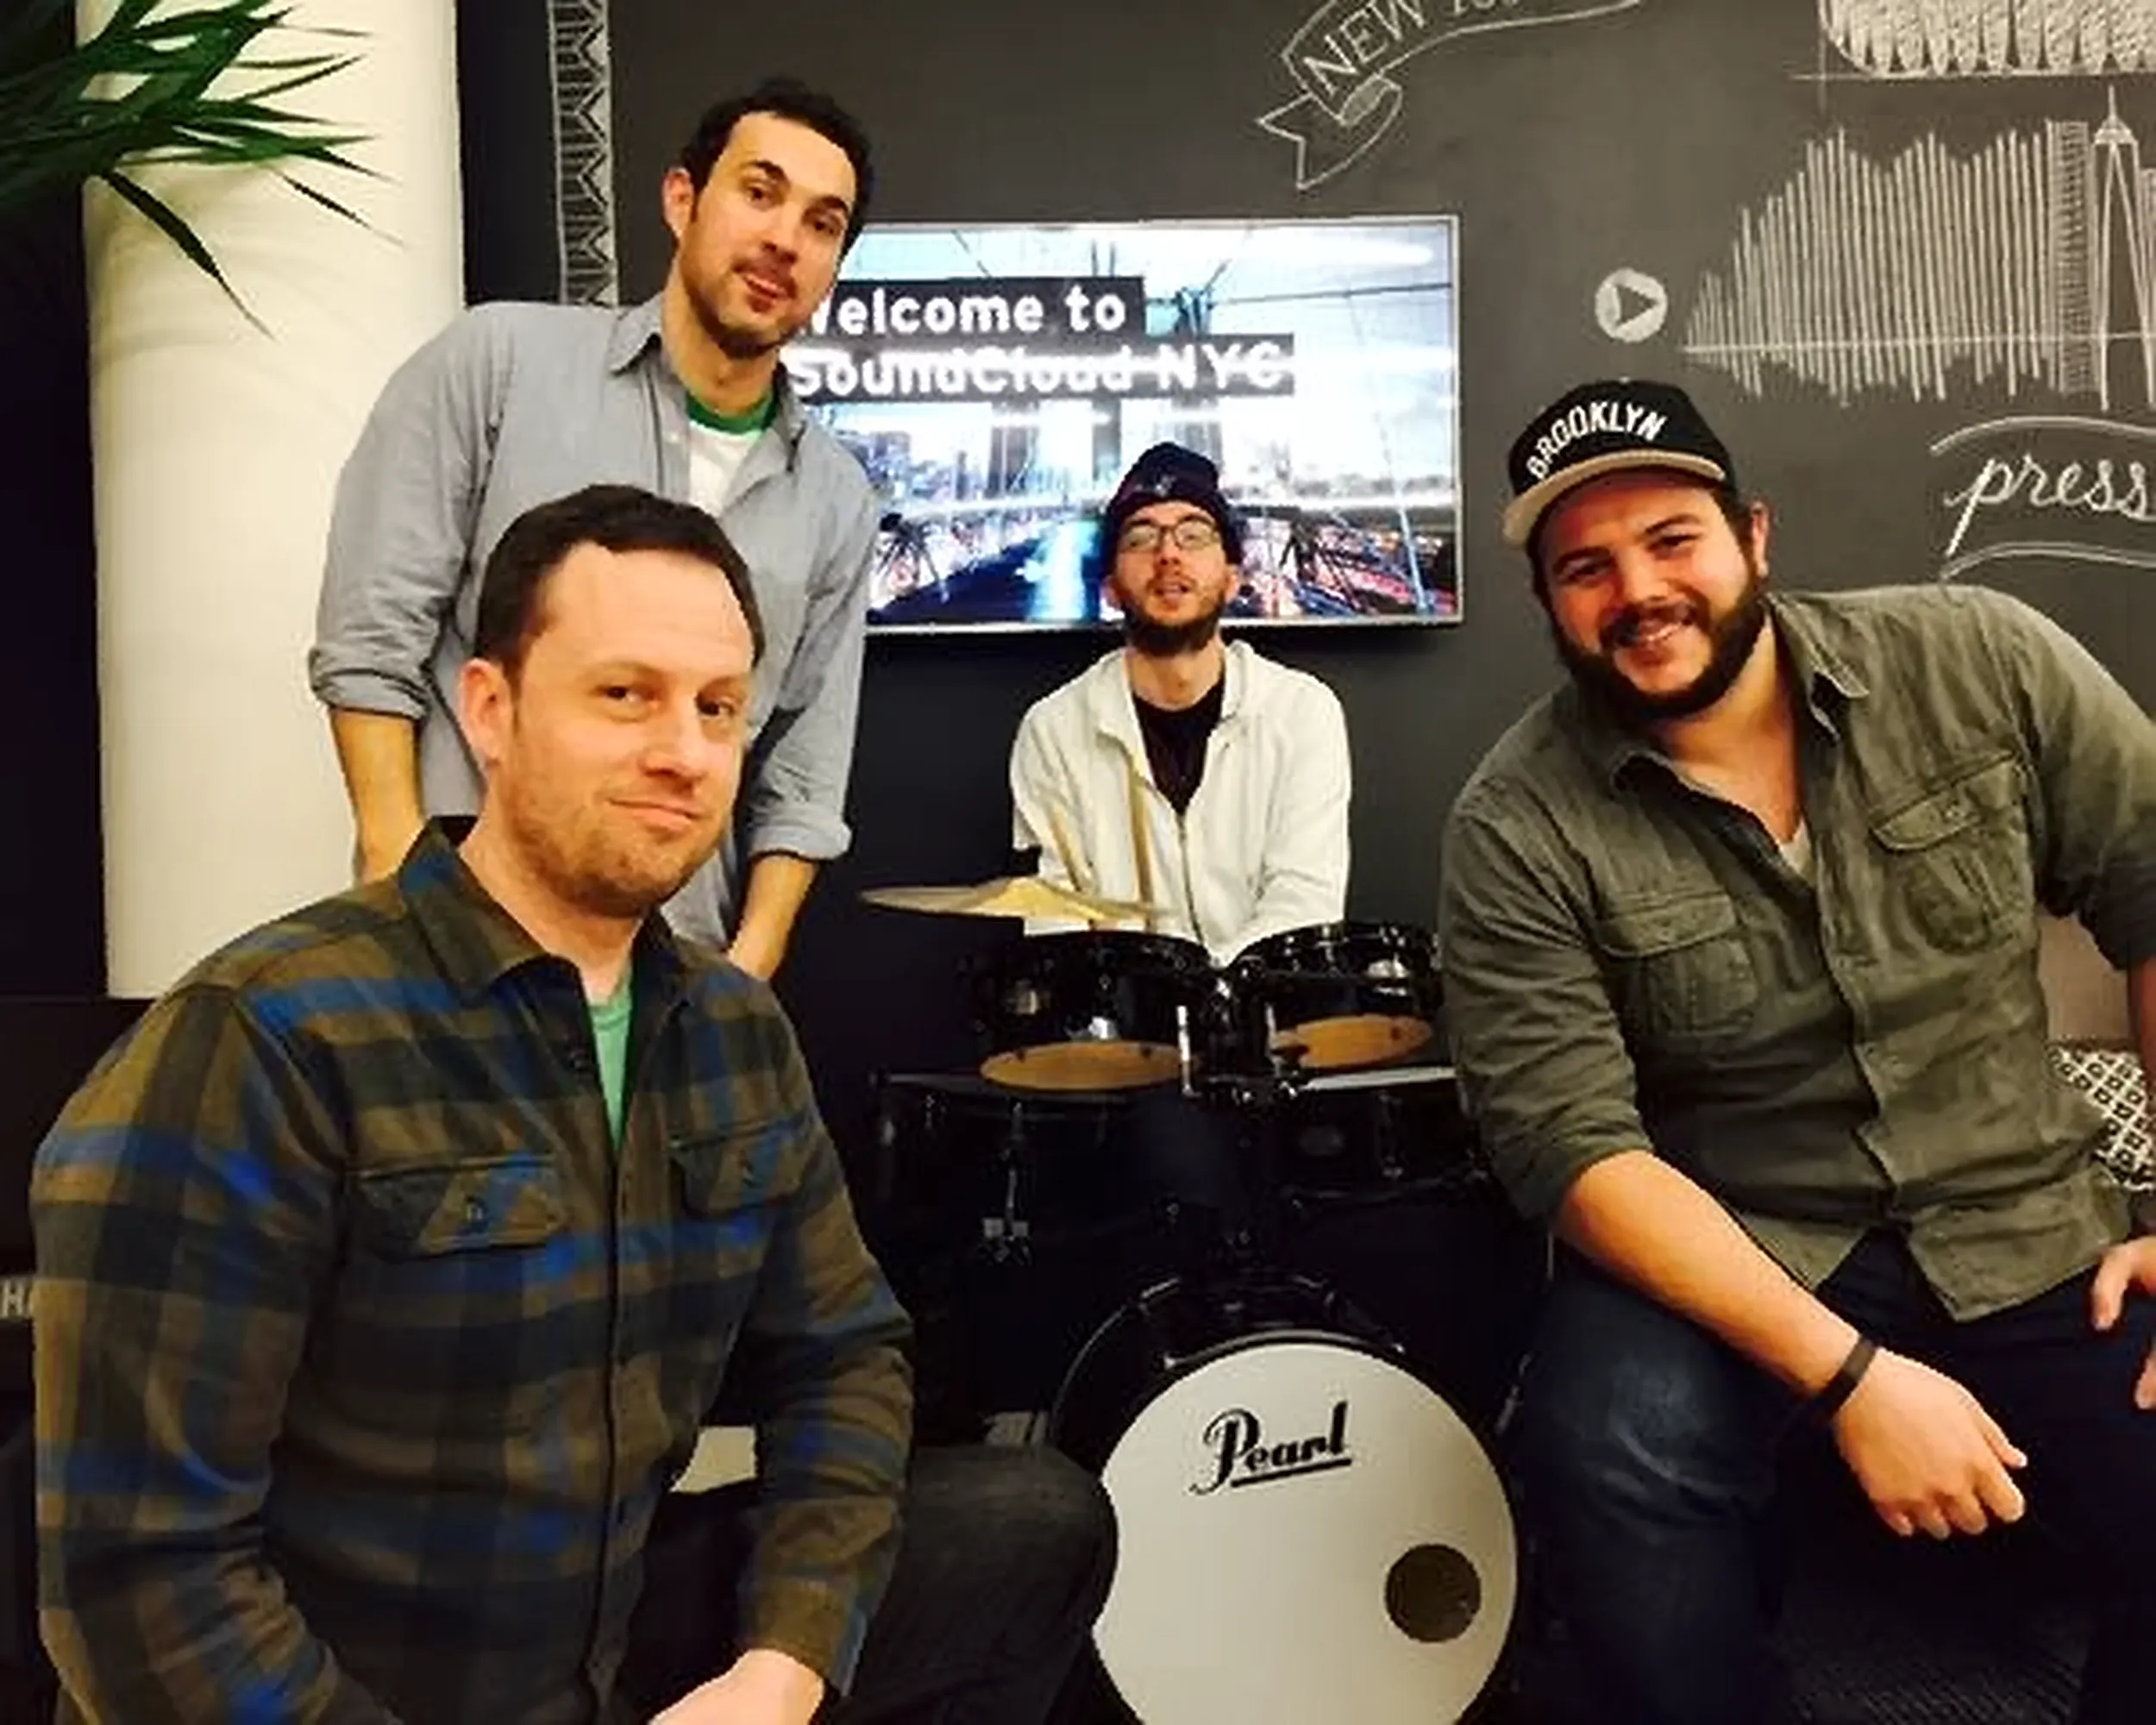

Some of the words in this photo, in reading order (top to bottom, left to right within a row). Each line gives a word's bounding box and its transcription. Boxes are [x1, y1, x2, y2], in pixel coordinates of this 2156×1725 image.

[1303, 0, 1425, 96] NEW
[1064, 284, 1126, 332] to
[780, 343, 1131, 397] SoundCloud
[1157, 342, 1283, 389] NYC
[1526, 401, 1668, 480] BROOKLYN
[1944, 454, 2156, 557] press
[1189, 1401, 1348, 1496] Pearl
